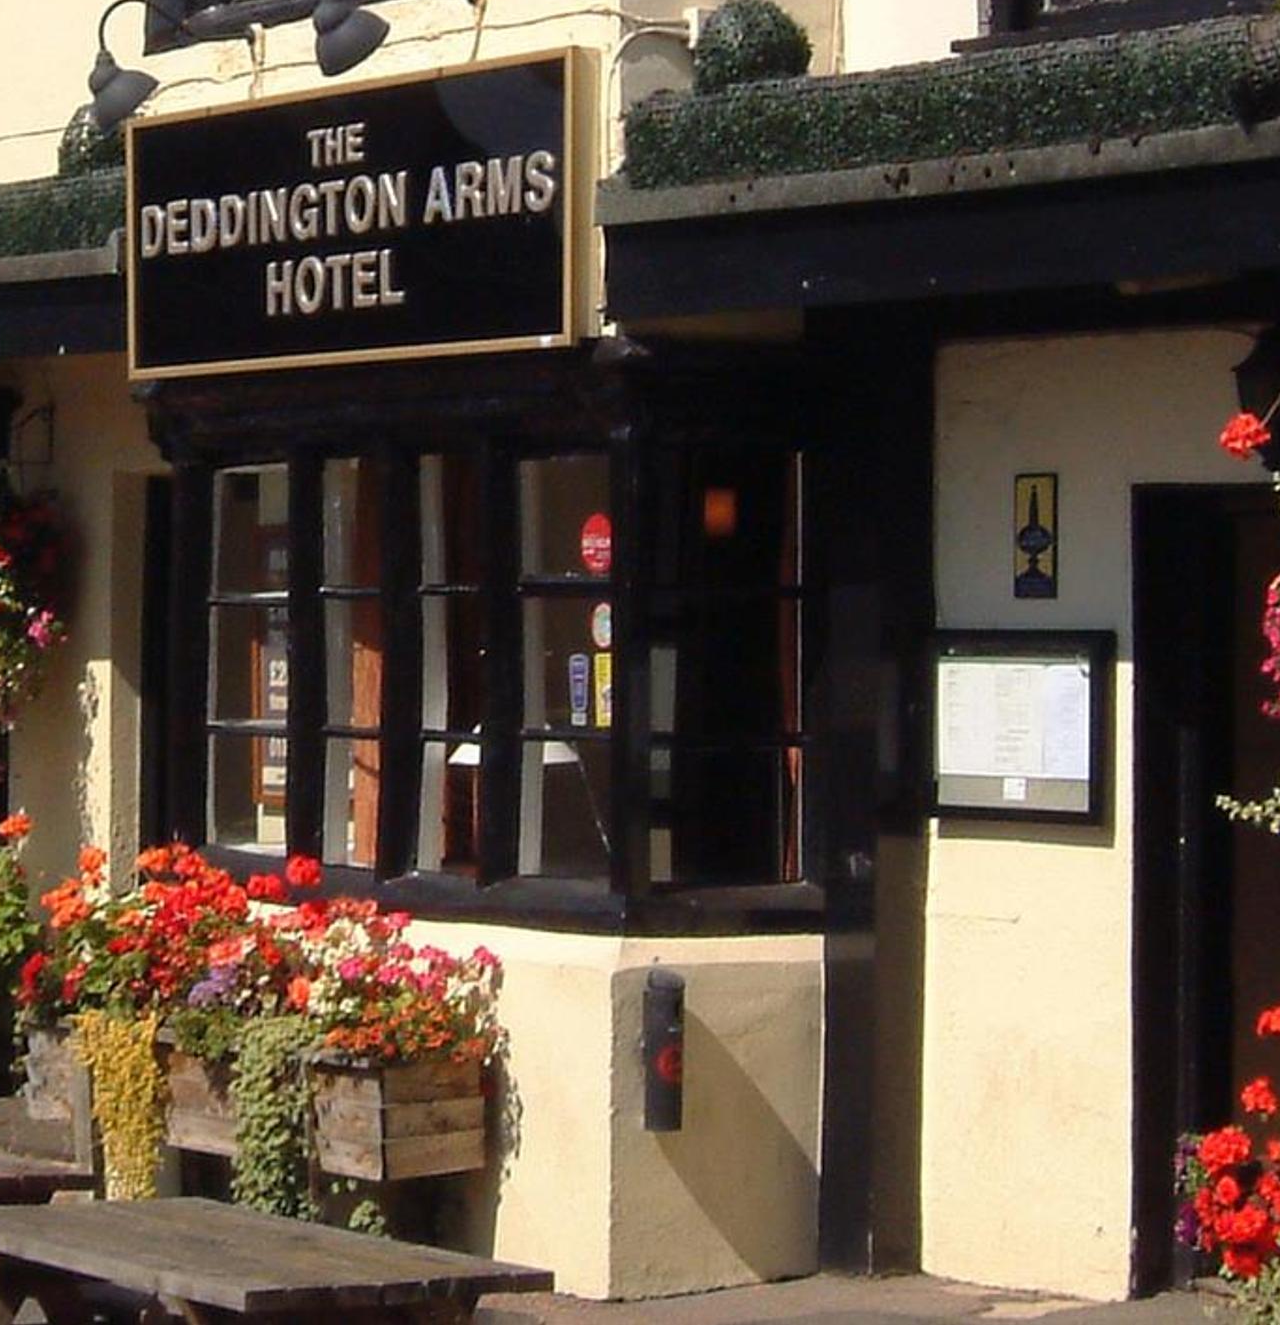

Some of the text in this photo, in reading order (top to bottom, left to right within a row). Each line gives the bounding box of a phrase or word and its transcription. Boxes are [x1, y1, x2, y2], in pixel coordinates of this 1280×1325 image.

[306, 122, 366, 167] THE
[140, 149, 555, 260] DEDDINGTON ARMS
[265, 248, 405, 317] HOTEL
